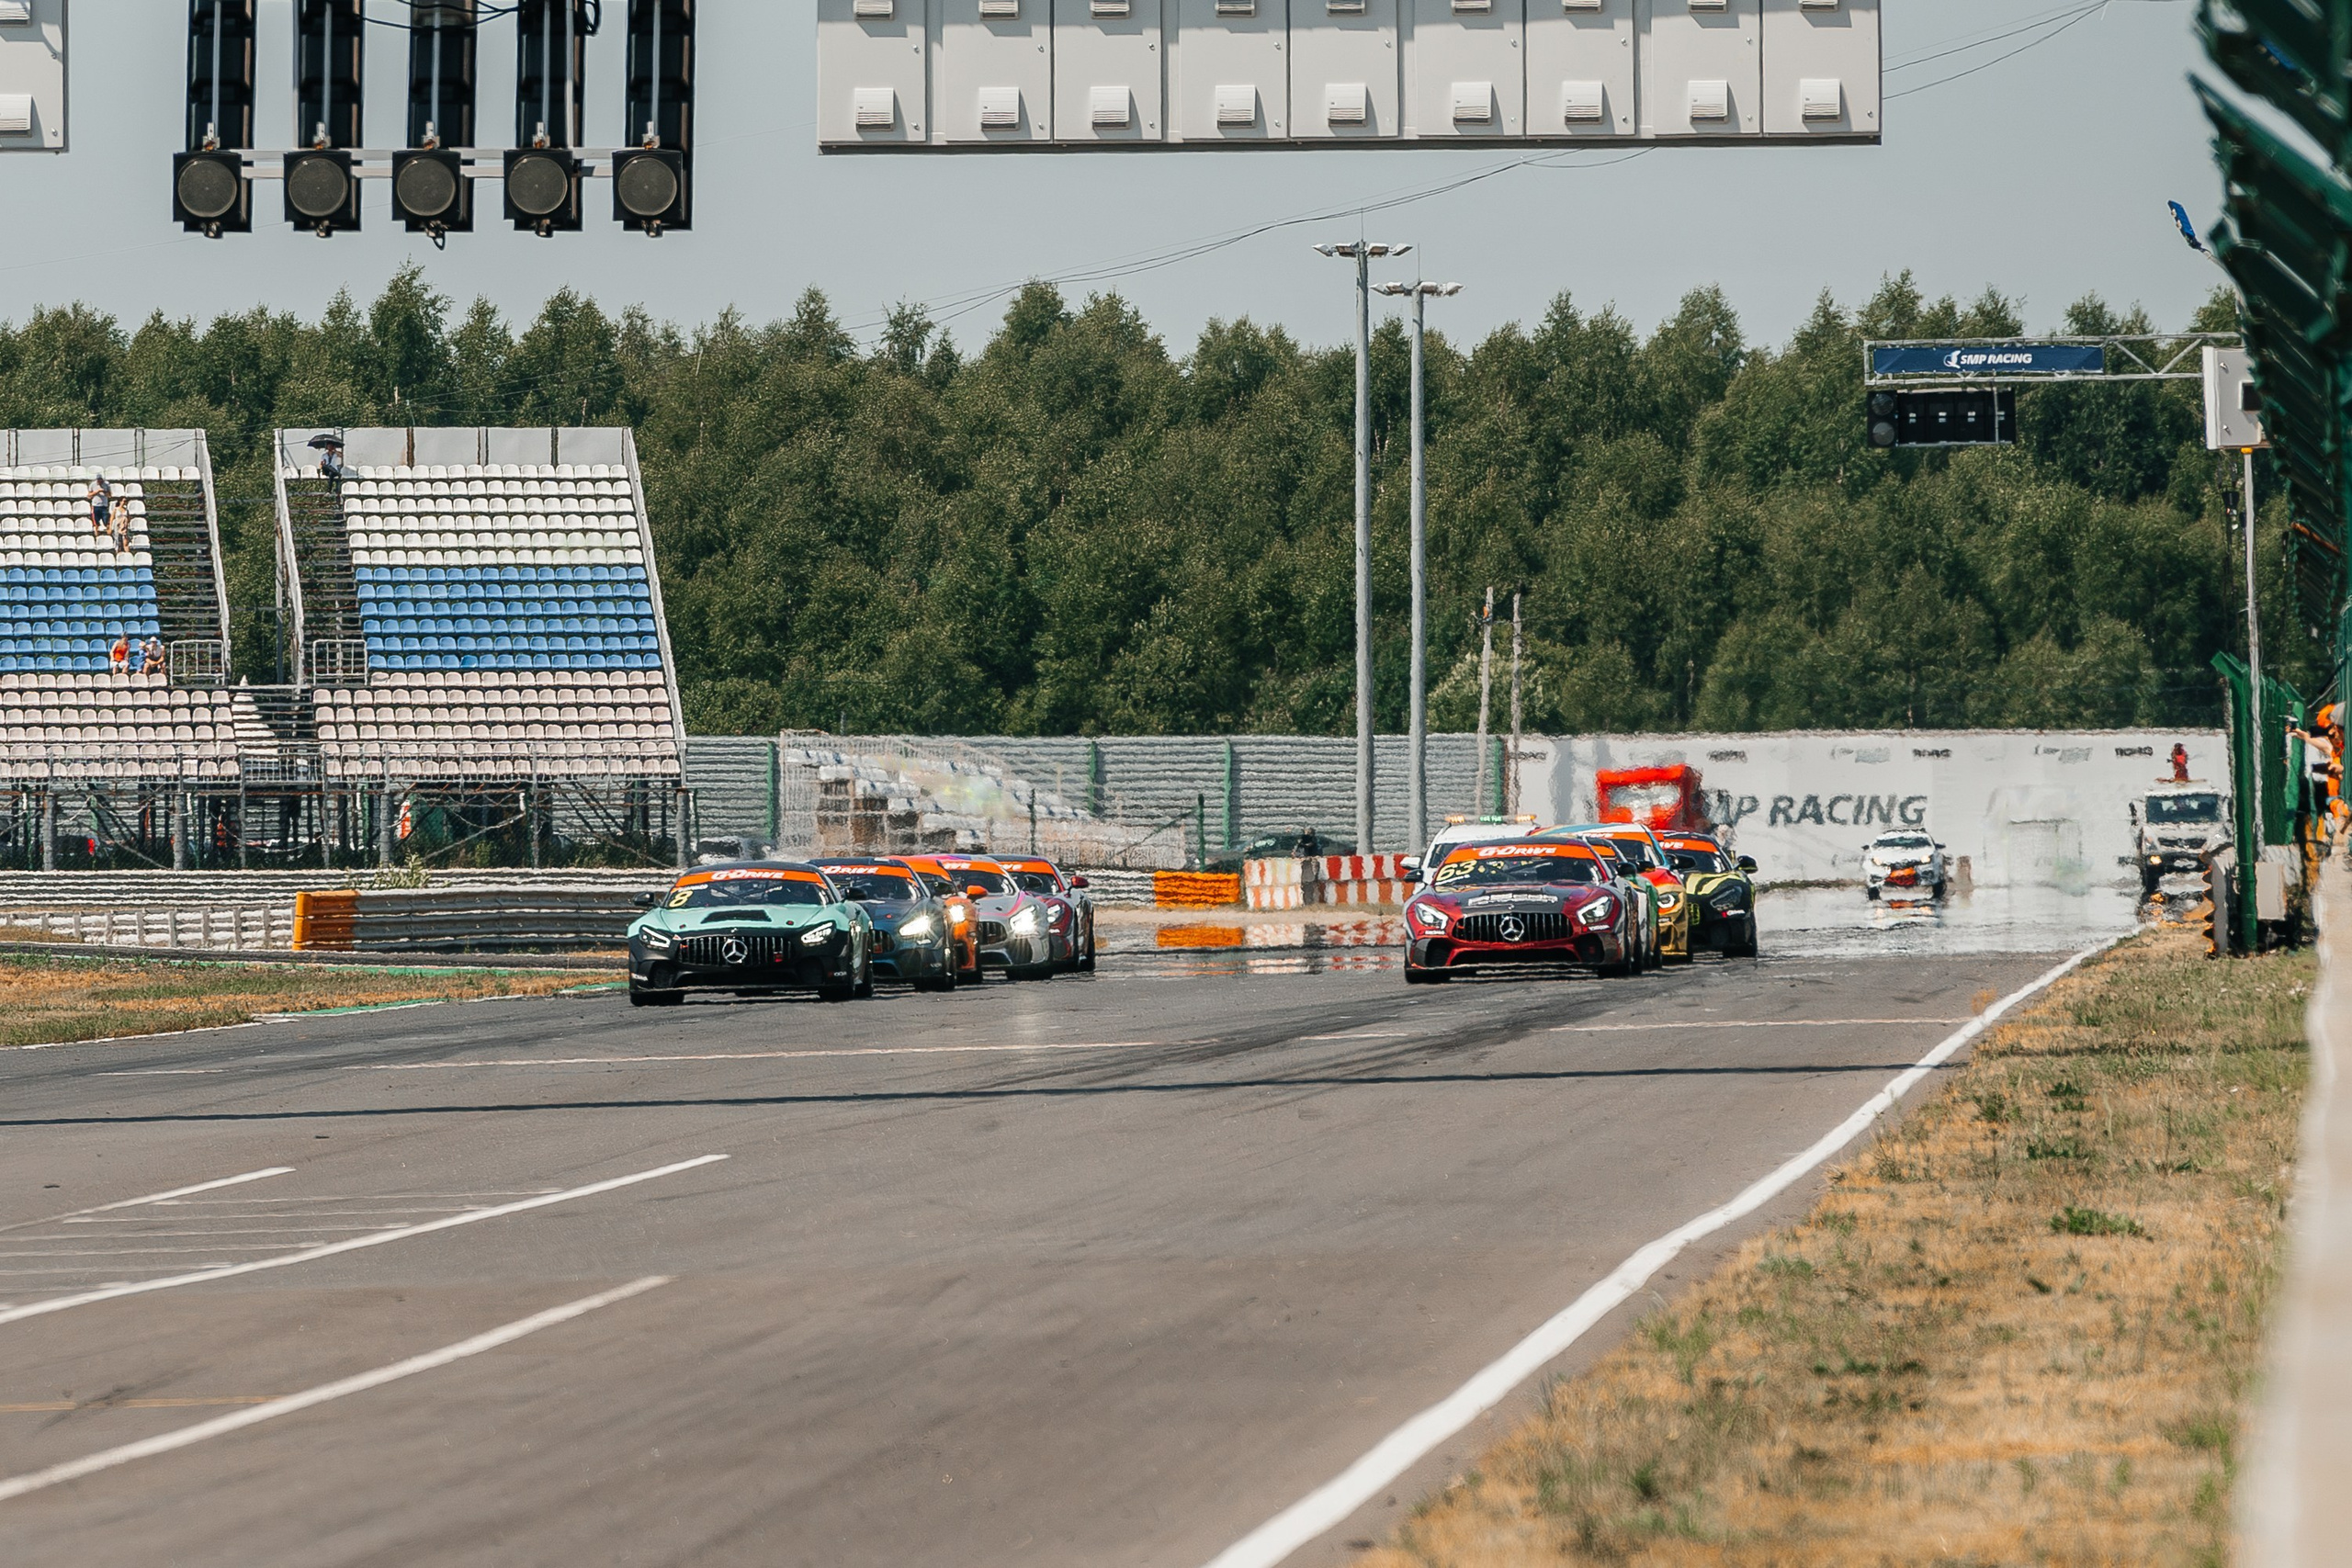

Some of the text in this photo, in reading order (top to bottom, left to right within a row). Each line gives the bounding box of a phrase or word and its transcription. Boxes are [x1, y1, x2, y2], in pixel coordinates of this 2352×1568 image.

[1960, 354, 2032, 365] SMP RACING
[1768, 794, 1928, 826] RACING
[1435, 860, 1477, 882] 63
[669, 890, 694, 908] 8
